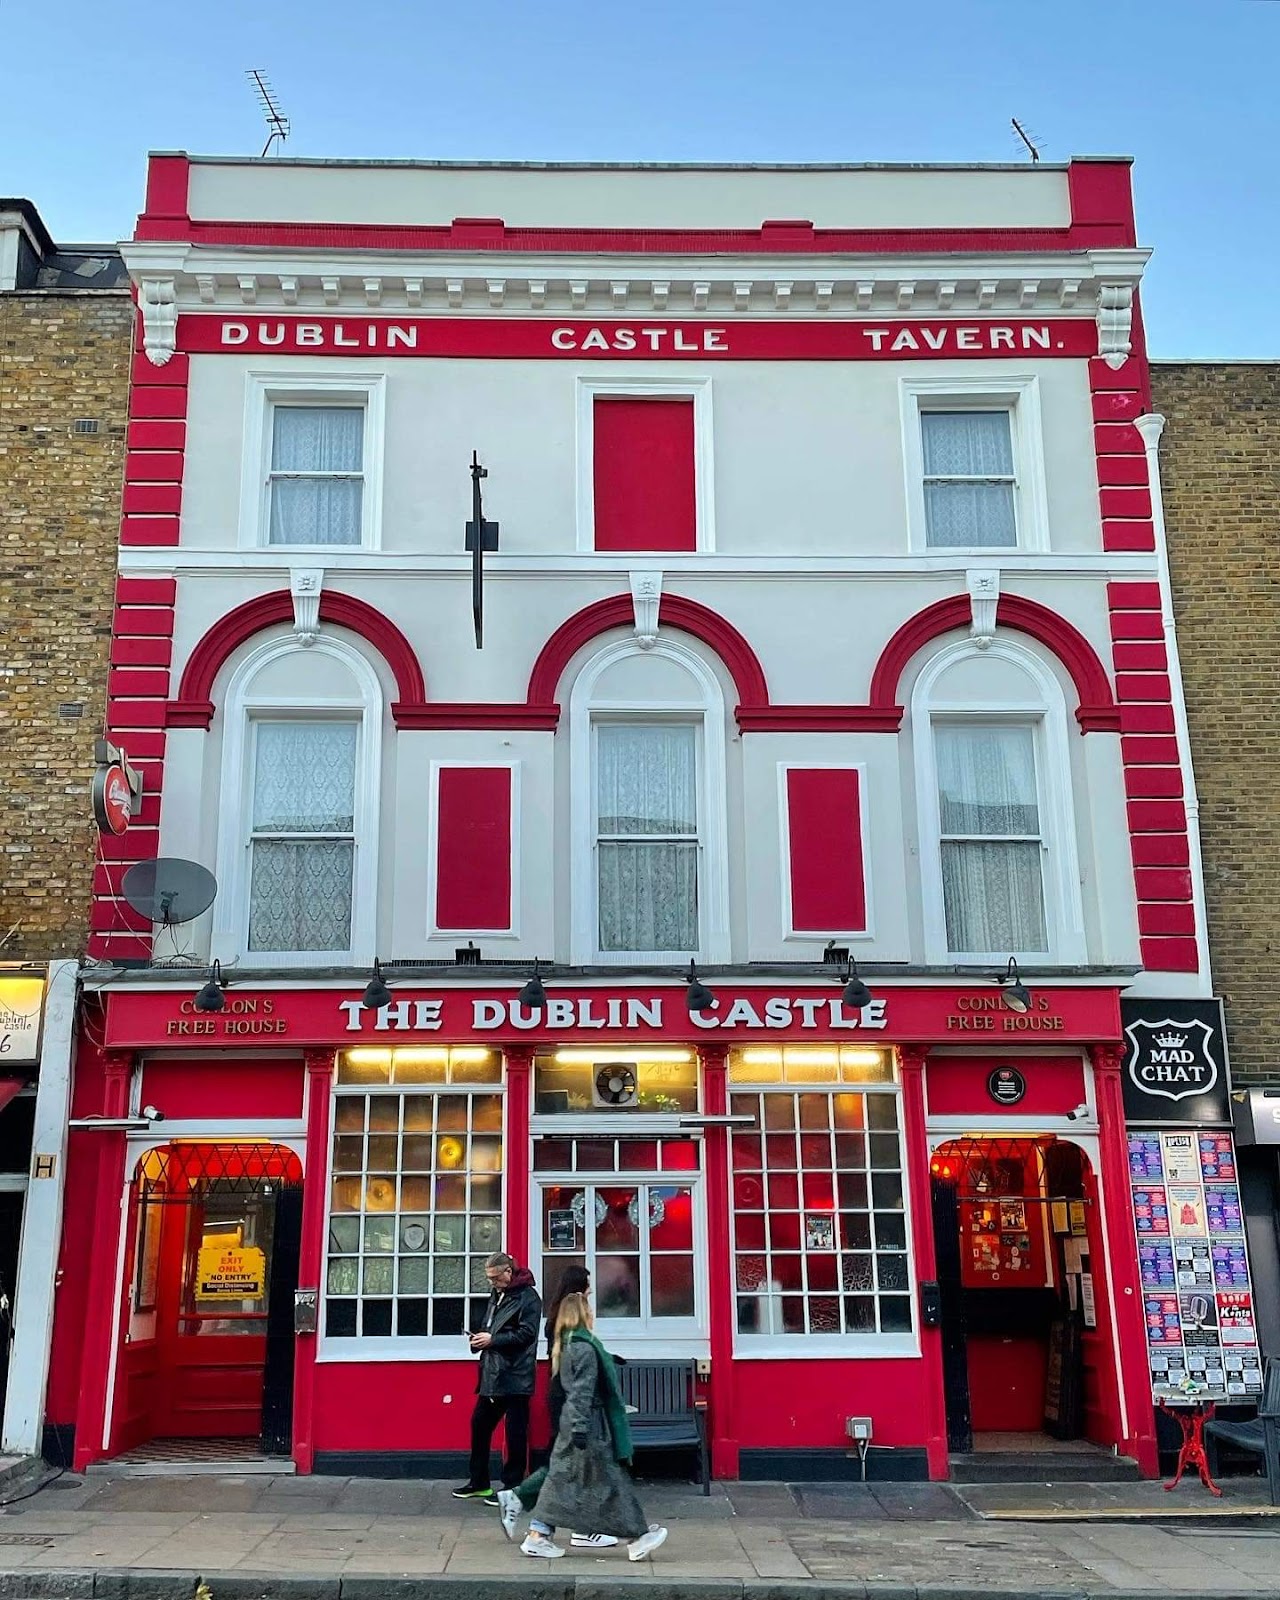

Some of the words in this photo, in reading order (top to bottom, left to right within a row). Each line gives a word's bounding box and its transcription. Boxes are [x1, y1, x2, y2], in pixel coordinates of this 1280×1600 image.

[221, 322, 417, 348] DUBLIN
[551, 327, 729, 350] CASTLE
[863, 326, 1065, 350] TAVERN.
[339, 1000, 443, 1030] THE
[472, 999, 662, 1029] DUBLIN
[689, 998, 887, 1029] CASTLE
[4, 1015, 32, 1031] castle
[167, 1020, 216, 1035] FREE
[224, 1019, 287, 1034] HOUSE
[946, 1015, 995, 1030] FREE
[1003, 1016, 1064, 1031] HOUSE
[1150, 1050, 1195, 1063] MAD
[1141, 1066, 1205, 1081] CHAT
[36, 1157, 53, 1178] H
